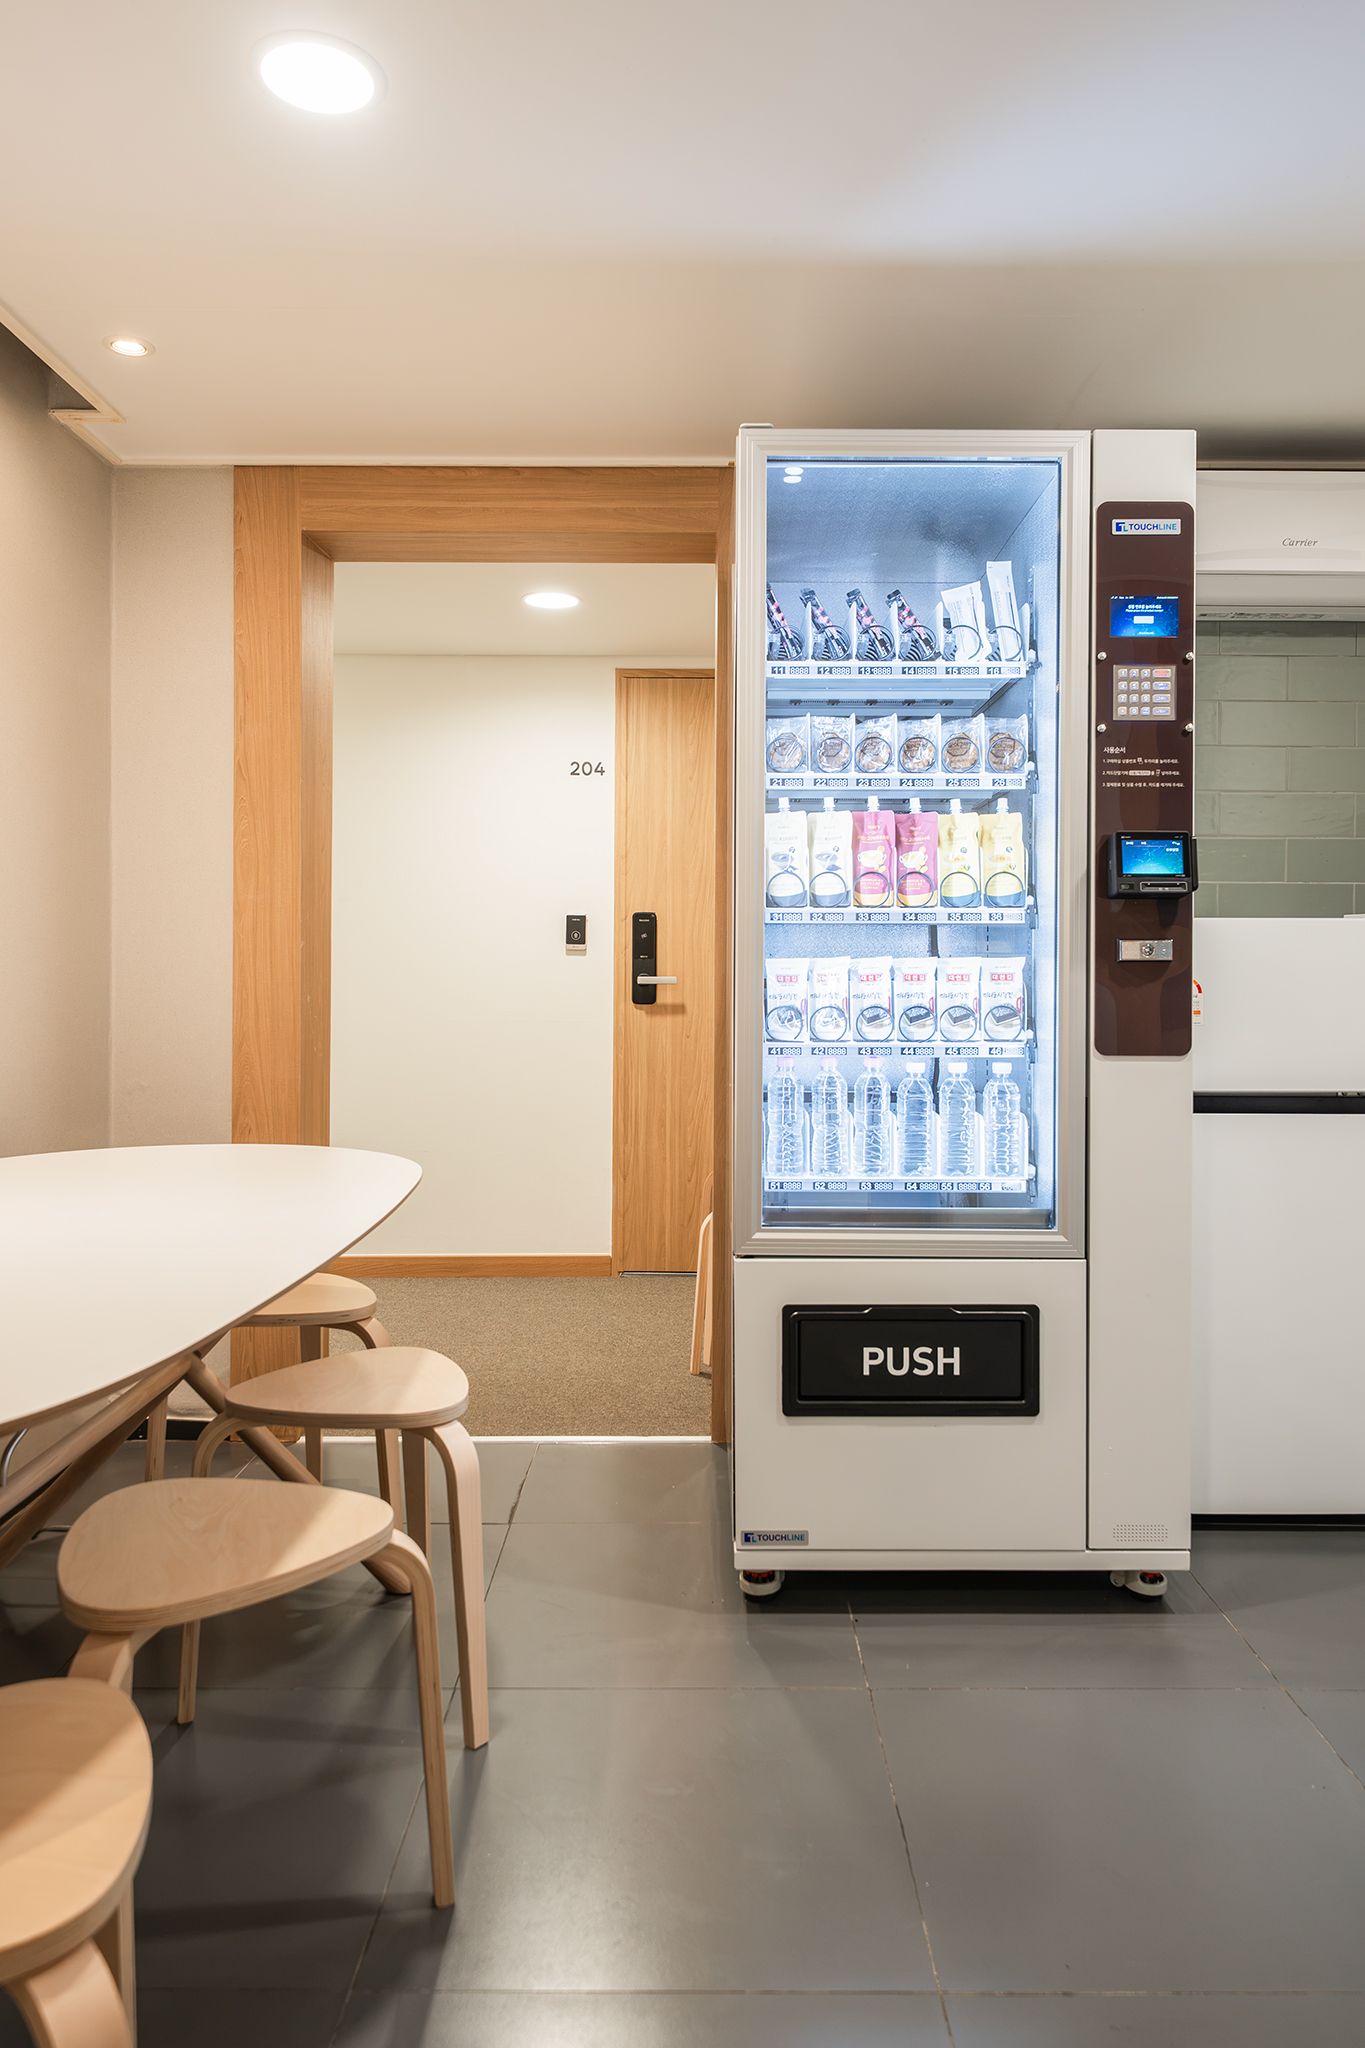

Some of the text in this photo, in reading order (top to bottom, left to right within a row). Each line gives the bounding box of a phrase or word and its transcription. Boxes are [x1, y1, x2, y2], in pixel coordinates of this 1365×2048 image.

[1129, 523, 1177, 531] TOUCHLINE
[1282, 537, 1318, 547] Carrier
[773, 667, 785, 675] 11
[819, 667, 831, 675] 12
[859, 667, 872, 675] 13
[903, 667, 915, 675] 14
[946, 667, 960, 675] 15
[988, 667, 1001, 675] 16
[1103, 746, 1126, 754] 사용순서
[570, 761, 605, 776] 204
[862, 1346, 960, 1376] PUSH
[758, 1533, 805, 1542] TOUCHLINE
